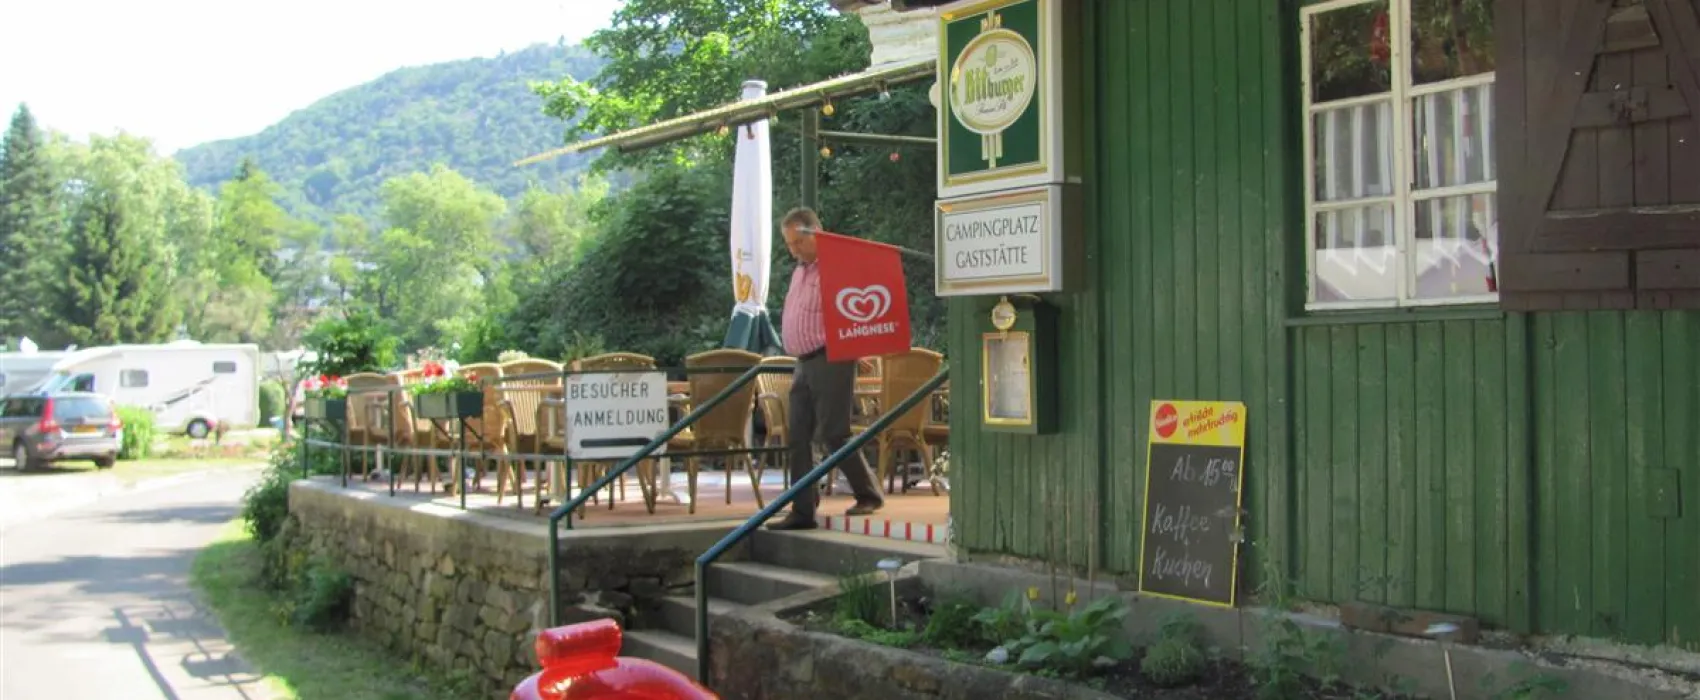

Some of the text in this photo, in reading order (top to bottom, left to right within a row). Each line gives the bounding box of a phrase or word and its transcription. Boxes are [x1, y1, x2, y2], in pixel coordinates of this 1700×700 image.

[964, 66, 1025, 105] Bitburger
[945, 215, 1038, 242] CAMPINGPLATZ
[955, 244, 1028, 269] GASTSTÄTTE
[838, 322, 895, 340] LANGNESE
[570, 382, 649, 399] BESUCHER
[573, 408, 665, 427] ANMELDUNG
[1169, 454, 1196, 482] Ab
[1151, 502, 1211, 542] Kaffee
[1152, 545, 1212, 588] Kuchen
